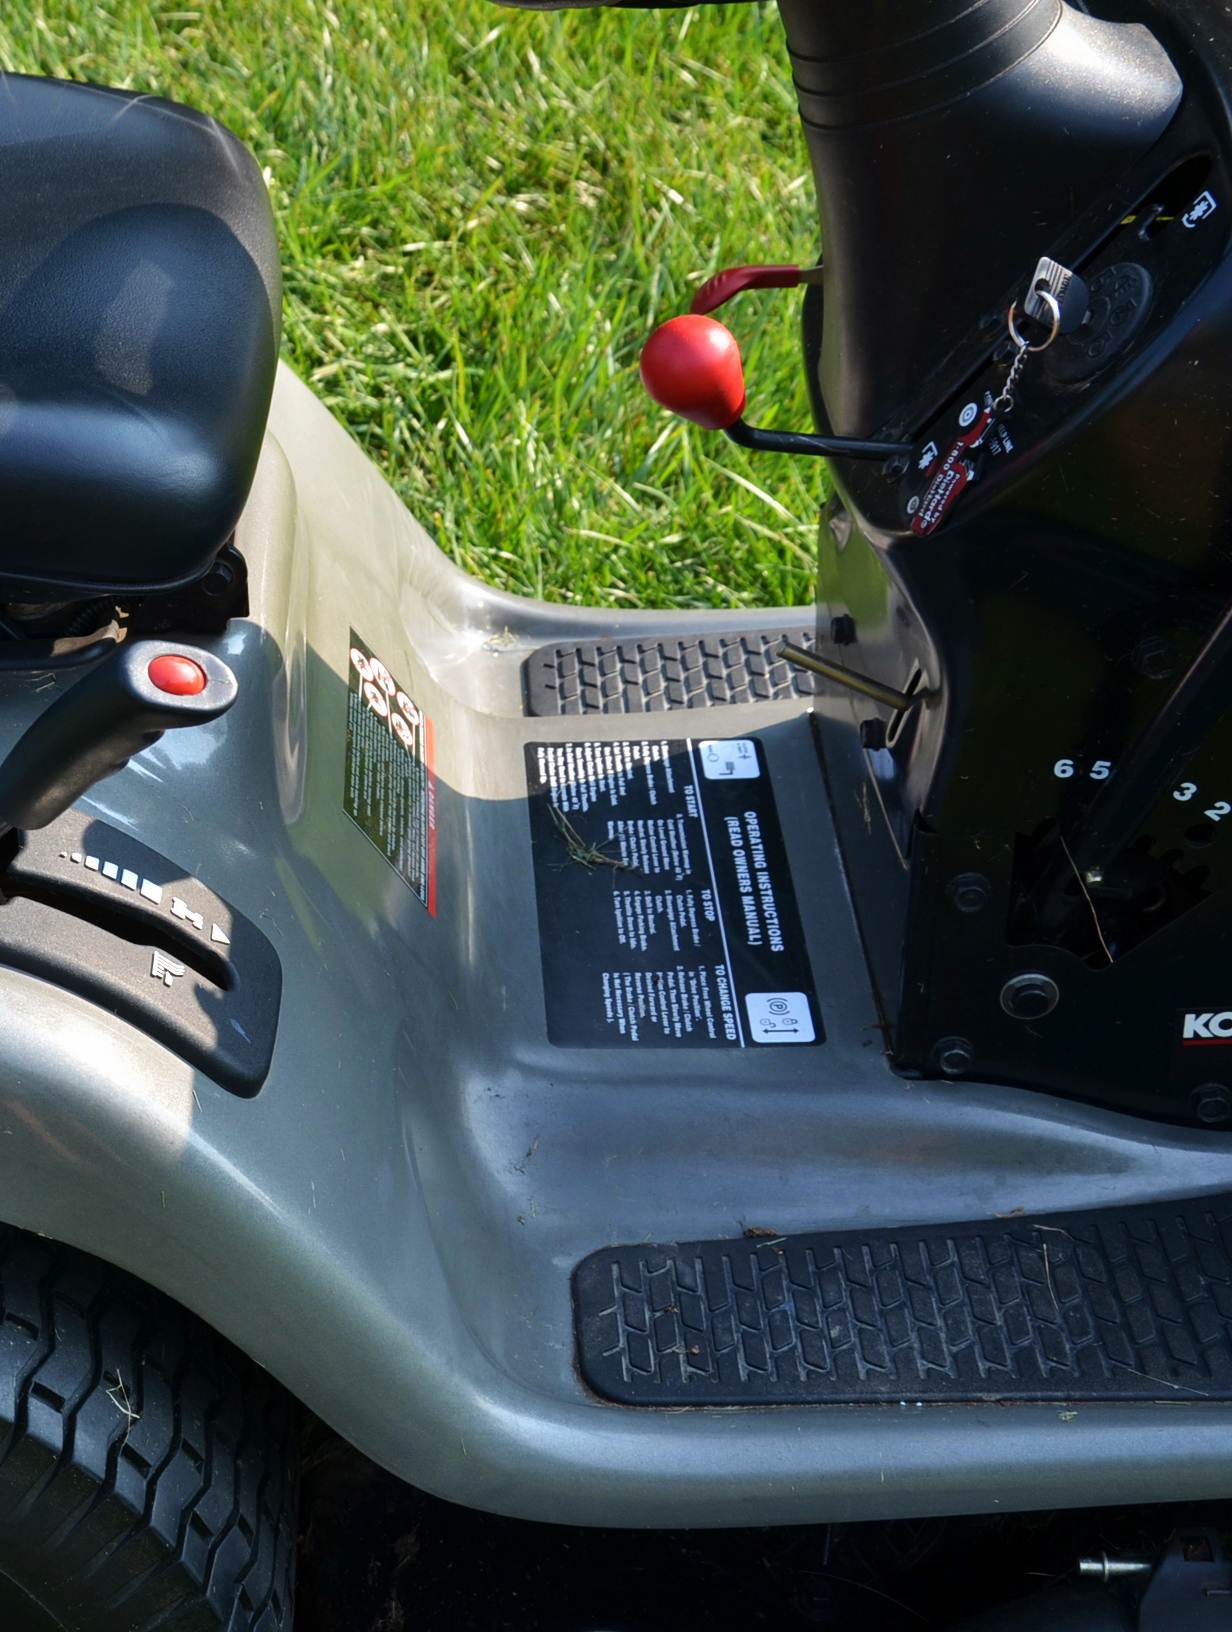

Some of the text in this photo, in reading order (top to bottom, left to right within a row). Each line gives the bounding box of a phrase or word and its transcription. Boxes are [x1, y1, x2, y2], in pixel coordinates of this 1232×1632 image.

[944, 441, 964, 471] 1-800
[924, 470, 954, 521] DieHard
[1053, 759, 1231, 821] 6 5 3 2
[684, 785, 698, 817] TO START
[724, 816, 762, 945] (READ OWNERS MANUAL)
[744, 811, 784, 952] OPERATING INSTRUCTIONS
[676, 895, 684, 911] Clutch
[686, 895, 694, 907] Fully
[701, 889, 715, 921] TO STOP
[688, 908, 697, 928] Depress
[691, 928, 700, 943] Brake
[602, 973, 611, 997] Changing
[624, 976, 632, 986] The
[634, 972, 642, 993] Reverse
[645, 972, 654, 992] Desired
[699, 971, 707, 986] Place
[615, 989, 623, 1017] Necessary
[625, 987, 633, 1002] Brake
[659, 991, 668, 1010] Control
[678, 972, 686, 993] Release
[684, 1014, 693, 1032] Clutch
[701, 987, 709, 999] Free
[715, 965, 736, 1040] TO CHANGE SPEED
[604, 998, 613, 1018] Speeds
[648, 993, 657, 1015] Forward
[672, 1004, 680, 1021] Slowly
[704, 1000, 712, 1017] Wheel
[628, 1007, 636, 1024] Clutch
[661, 1012, 669, 1027] Lever
[618, 1018, 626, 1034] When
[631, 1025, 639, 1041] Pedal
[707, 1018, 716, 1038] Control
